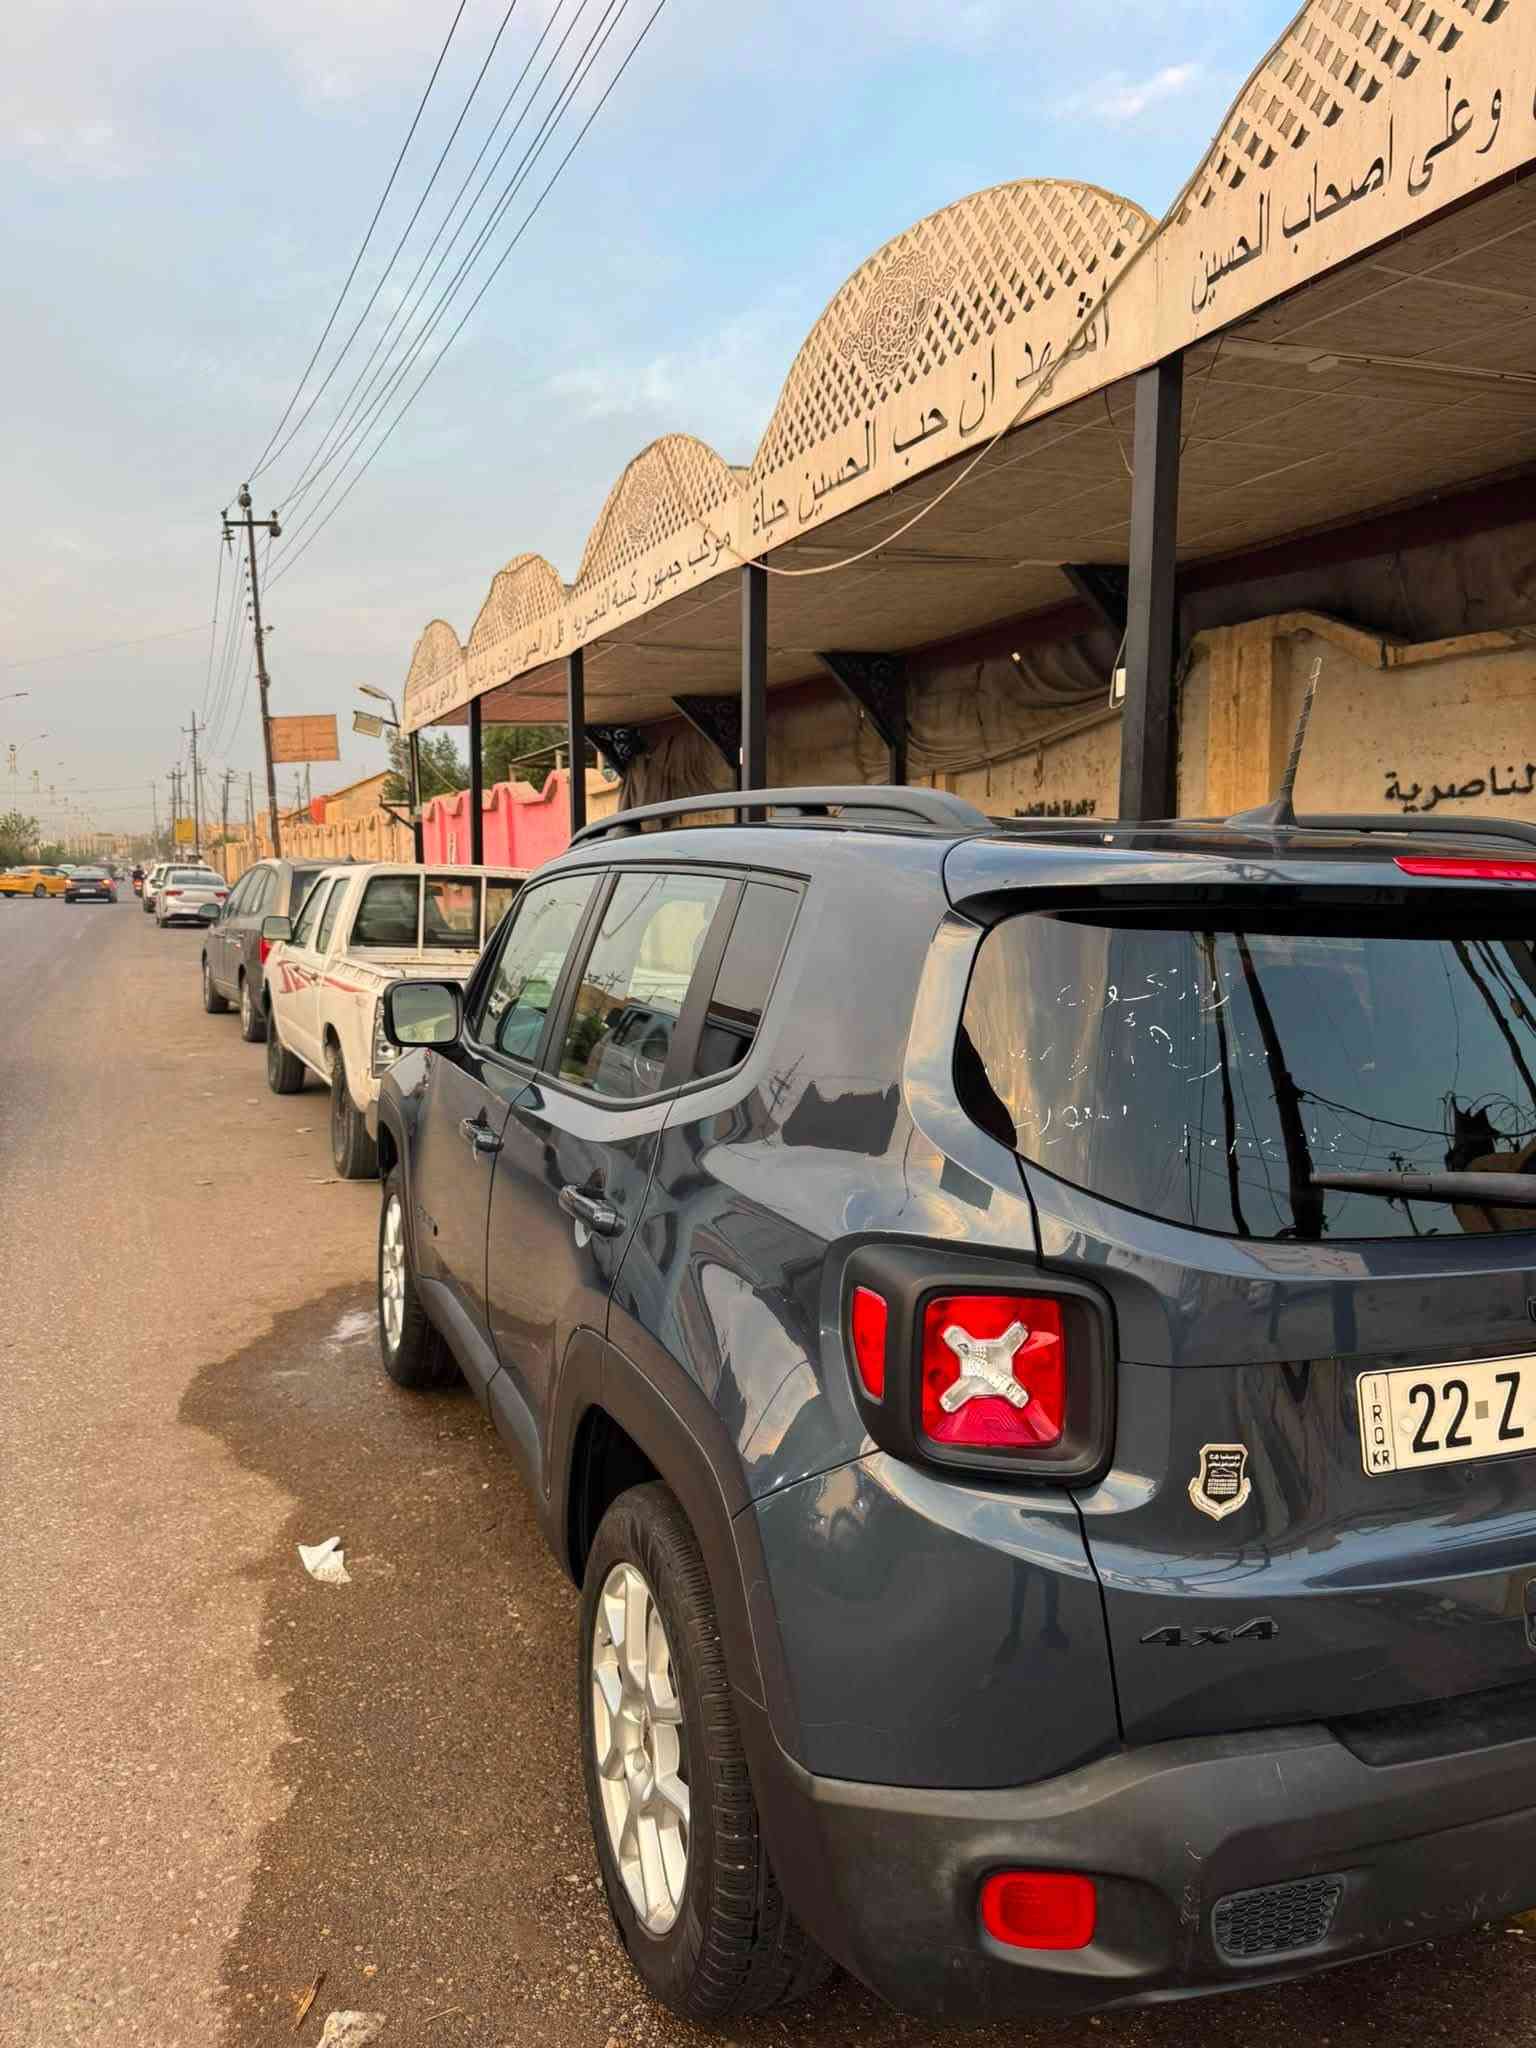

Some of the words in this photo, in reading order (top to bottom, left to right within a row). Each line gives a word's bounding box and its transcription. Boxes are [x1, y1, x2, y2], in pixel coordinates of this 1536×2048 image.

[1281, 112, 1393, 255] اصحاب
[1191, 189, 1270, 315] الحسين
[797, 418, 878, 526] الحسين
[893, 407, 949, 467] حب
[687, 523, 732, 575] موكب
[752, 485, 789, 544] حياة
[1408, 1379, 1473, 1454] 22
[1495, 1371, 1525, 1441] Z
[1372, 1449, 1391, 1468] KR
